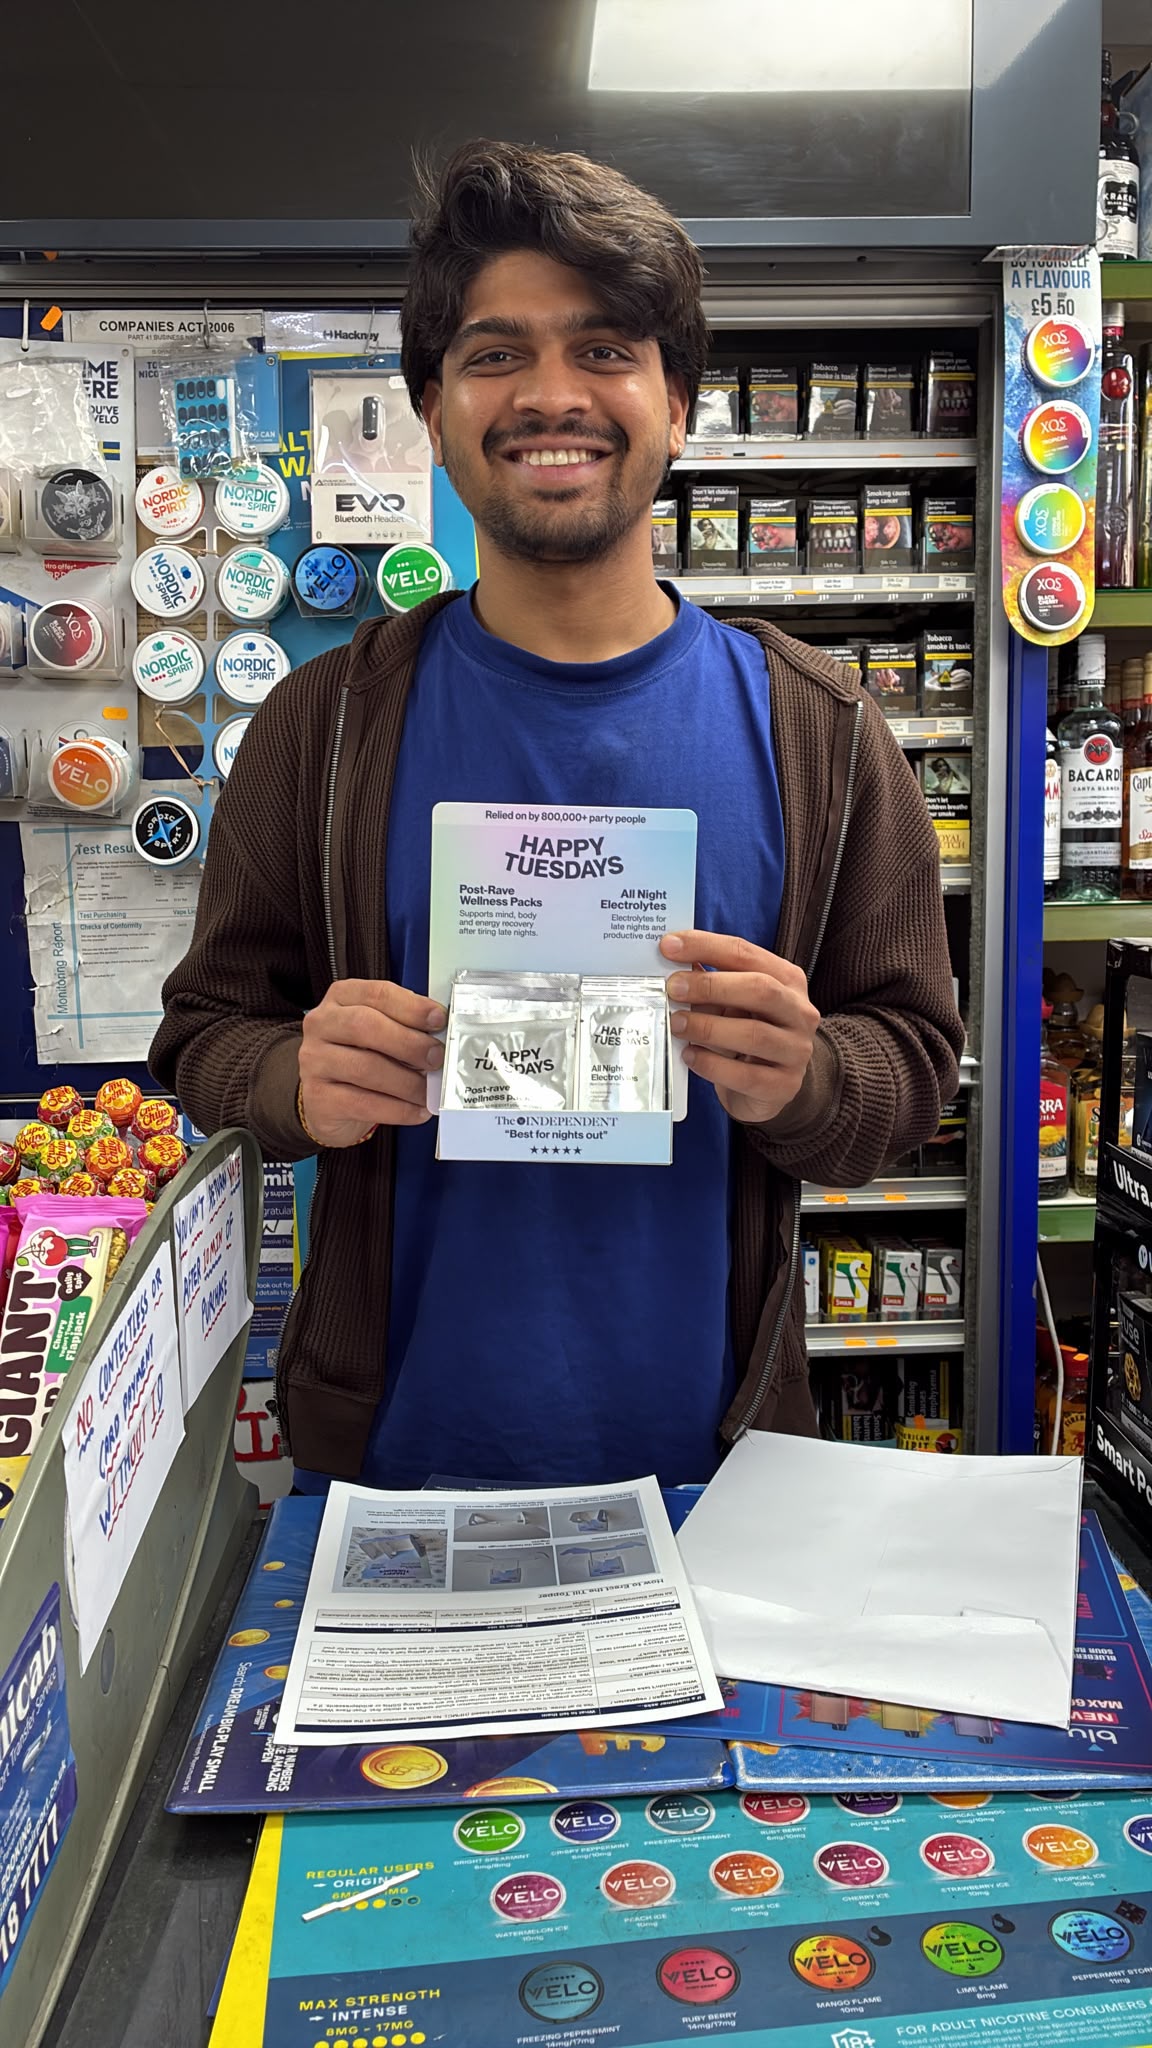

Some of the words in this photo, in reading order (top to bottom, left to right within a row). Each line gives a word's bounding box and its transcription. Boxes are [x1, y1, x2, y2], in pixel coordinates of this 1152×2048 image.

[1103, 192, 1137, 204] KRAKEN
[1012, 270, 1022, 289] A
[1026, 270, 1091, 289] FLAVOUR
[1031, 293, 1075, 316] £5.50
[99, 320, 176, 333] COMPANIES
[178, 321, 204, 333] ACT
[207, 321, 235, 333] 2006
[333, 329, 379, 343] Hackney
[1042, 329, 1071, 349] XQS
[1040, 416, 1068, 434] XQS
[142, 484, 191, 510] NORDIC
[223, 484, 278, 504] NORDIC
[335, 493, 406, 512] EVO
[151, 497, 189, 519] SPIRIT
[247, 501, 277, 513] SPIRIT
[334, 514, 373, 523] Bluetooth
[1035, 507, 1049, 537] XQS
[151, 552, 187, 608] NORDIC
[225, 566, 276, 592] NORDIC
[303, 553, 347, 601] VELO
[383, 566, 440, 590] VELO
[1036, 577, 1064, 592] XQS
[155, 582, 177, 610] SPIRIT
[245, 586, 273, 601] SPIRIT
[60, 610, 87, 642] XQS
[927, 634, 953, 642] Tobacco
[138, 648, 193, 680] NORDIC
[167, 660, 195, 679] SPIRIT
[223, 658, 277, 672] NORDIC
[247, 671, 277, 681] SPIRIT
[56, 759, 109, 795] VELO
[147, 812, 177, 838] NORDIC
[485, 810, 514, 821] Relied
[515, 812, 527, 821] on
[528, 812, 540, 823] by
[541, 812, 588, 823] 800,000+
[589, 814, 613, 825] party
[614, 813, 647, 825] people
[153, 825, 183, 849] SPIRIT
[519, 833, 605, 858] HAPPY
[76, 843, 102, 856] Test
[504, 851, 625, 880] TUESDAYS
[459, 884, 516, 896] Post-Rave
[620, 889, 635, 899] All
[636, 889, 668, 901] Night
[459, 895, 509, 907] Wellness
[510, 897, 543, 908] Packs
[600, 899, 667, 912] Electrolytes
[80, 911, 93, 919] Test
[93, 911, 127, 920] Purchasing
[459, 909, 493, 920] Supports
[494, 910, 517, 920] mind,
[517, 911, 537, 921] body
[459, 919, 474, 927] and
[475, 919, 500, 929] energy
[501, 920, 534, 929] recovery
[611, 914, 655, 924] Electrolytes
[655, 914, 667, 923] for
[80, 923, 100, 931] Checks
[109, 922, 143, 931] Conformity
[458, 927, 476, 936] after
[477, 928, 496, 937] tiring
[497, 928, 512, 937] late
[513, 929, 539, 938] nights.
[603, 931, 644, 941] productive
[610, 922, 625, 931] late
[625, 922, 650, 932] nights
[651, 923, 667, 932] and
[53, 920, 65, 957] Report
[56, 958, 68, 1015] Monitoring
[464, 1083, 511, 1095] Post-rave
[463, 1093, 506, 1105] wellness
[494, 1115, 516, 1126] The
[526, 1115, 620, 1128] INDEPENDENT
[535, 1129, 551, 1140] for
[551, 1129, 585, 1141] nights
[1112, 1159, 1150, 1207] Ultra
[175, 1215, 190, 1249] YOU
[183, 1264, 203, 1308] AFTER
[225, 1211, 235, 1242] OF
[926, 1295, 946, 1304] SWAN
[52, 1319, 67, 1351] Cherry
[65, 1310, 86, 1362] Flapjack
[0, 1270, 58, 1458] GIANT
[76, 1394, 94, 1447] NO
[151, 1266, 163, 1298] OR
[99, 1415, 120, 1481] CARD
[123, 1332, 156, 1420] PAYMENT
[99, 1405, 148, 1537] WITHOUT
[150, 1371, 164, 1423] ID
[1096, 1423, 1135, 1486] Smart
[605, 1583, 630, 1593] Erect
[643, 1578, 664, 1587] How
[538, 1590, 570, 1599] Topper
[232, 1661, 253, 1688] Search:
[222, 1687, 244, 1718] DREAM
[215, 1718, 235, 1735] BIG
[1066, 1727, 1118, 1745] blu
[208, 1734, 231, 1759] PLAY
[197, 1758, 222, 1794] SMALL
[265, 1754, 284, 1792] AMAZING
[277, 1754, 298, 1792] NUMBERS
[651, 1806, 710, 1820] VELO
[745, 1797, 804, 1811] VELO
[460, 1823, 519, 1838] VELO
[555, 1813, 615, 1829] VELO
[2, 1817, 32, 1892] BOOKING
[926, 1847, 987, 1863] VELO
[1029, 1839, 1091, 1854] VELO
[21, 1803, 59, 1910] 7777
[820, 1856, 882, 1872] VELO
[306, 1866, 381, 1880] REGULAR
[383, 1861, 435, 1874] USERS
[716, 1866, 778, 1881] VELO
[608, 1876, 669, 1892] VELO
[497, 1887, 560, 1905] VELO
[1055, 1925, 1126, 1944] VELO
[924, 1939, 998, 1958] VELO
[796, 1952, 867, 1971] VELO
[663, 1965, 733, 1985] VELO
[527, 1980, 597, 2000] VELO
[299, 1998, 339, 2012] MAX
[345, 1988, 442, 2008] STRENGTH
[332, 2004, 409, 2022] INTENSE
[682, 2014, 706, 2024] RUBY
[707, 2011, 737, 2021] BERRY
[897, 2023, 930, 2037] FOR
[931, 2017, 979, 2033] ADULT
[980, 2010, 1051, 2029] NICOTINE
[1052, 1998, 1148, 2020] CONSUMERS
[325, 2024, 359, 2037] 8MG
[375, 2019, 415, 2033] 17MG
[516, 2032, 562, 2045] FREEZING
[562, 2024, 621, 2040] PEPPERMINT
